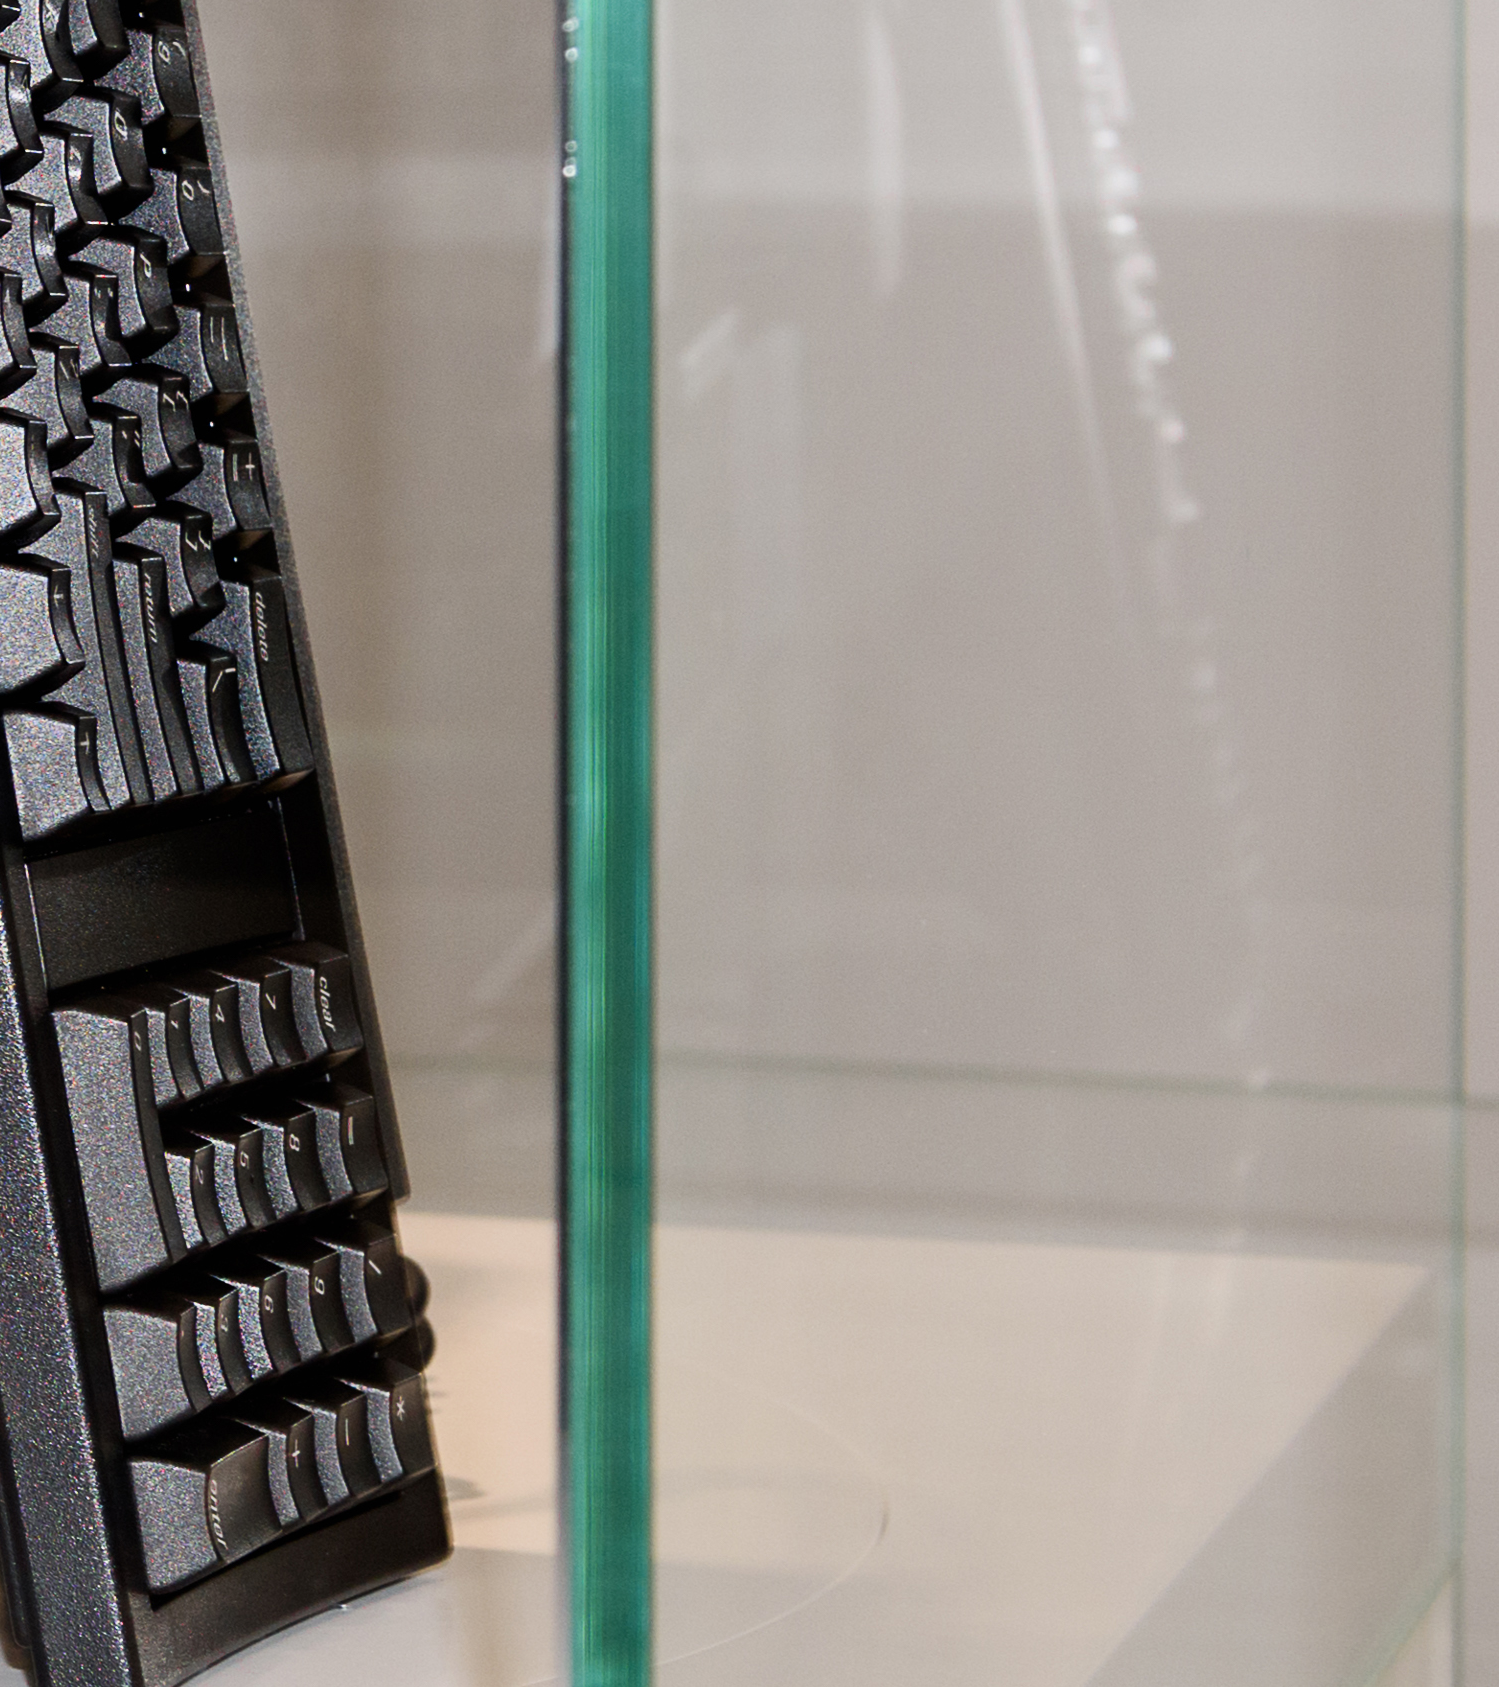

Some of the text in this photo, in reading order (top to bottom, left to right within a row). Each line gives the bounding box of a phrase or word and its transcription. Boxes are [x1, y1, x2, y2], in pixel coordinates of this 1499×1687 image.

[139, 252, 152, 278] P
[144, 572, 158, 644] return
[254, 591, 270, 662] delete
[265, 992, 277, 1010] 7
[319, 975, 336, 1033] clear
[215, 1004, 225, 1023] 4
[289, 1133, 301, 1152] 8
[240, 1151, 250, 1168] 5
[195, 1165, 204, 1185] 2
[314, 1276, 325, 1296] 9
[264, 1295, 274, 1313] 6
[209, 1479, 229, 1551] enter
